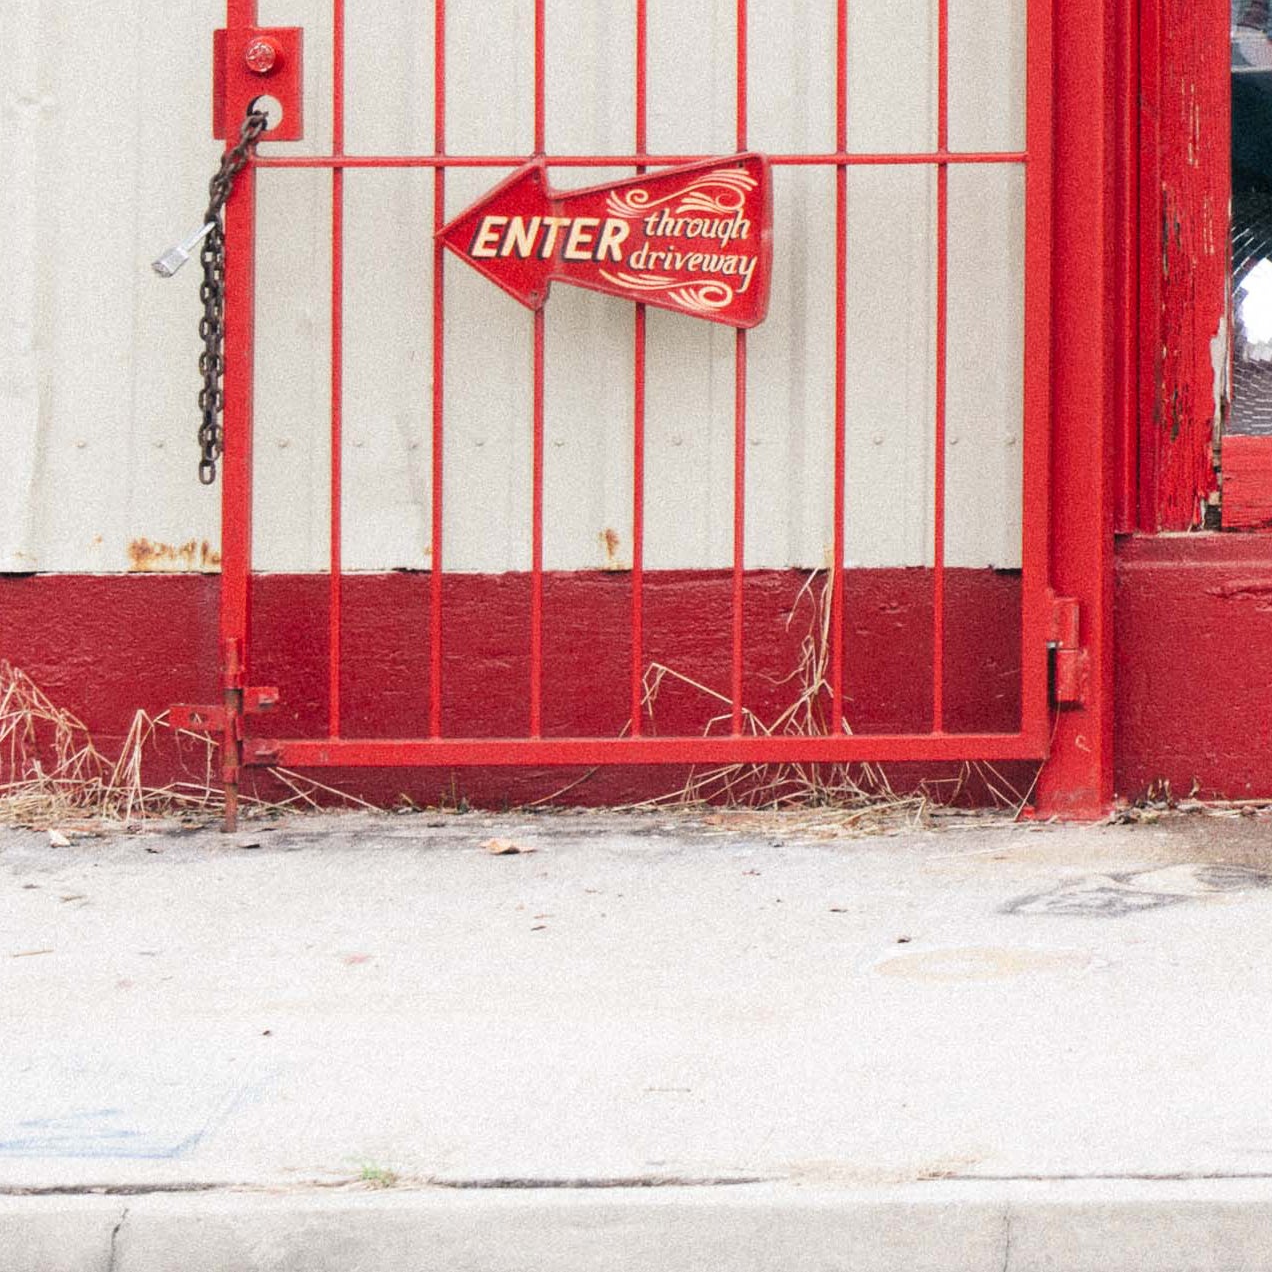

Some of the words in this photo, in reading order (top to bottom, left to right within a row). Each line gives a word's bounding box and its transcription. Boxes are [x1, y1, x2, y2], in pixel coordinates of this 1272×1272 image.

[469, 215, 631, 263] ENTER
[643, 207, 751, 249] through
[629, 242, 758, 293] driveway
